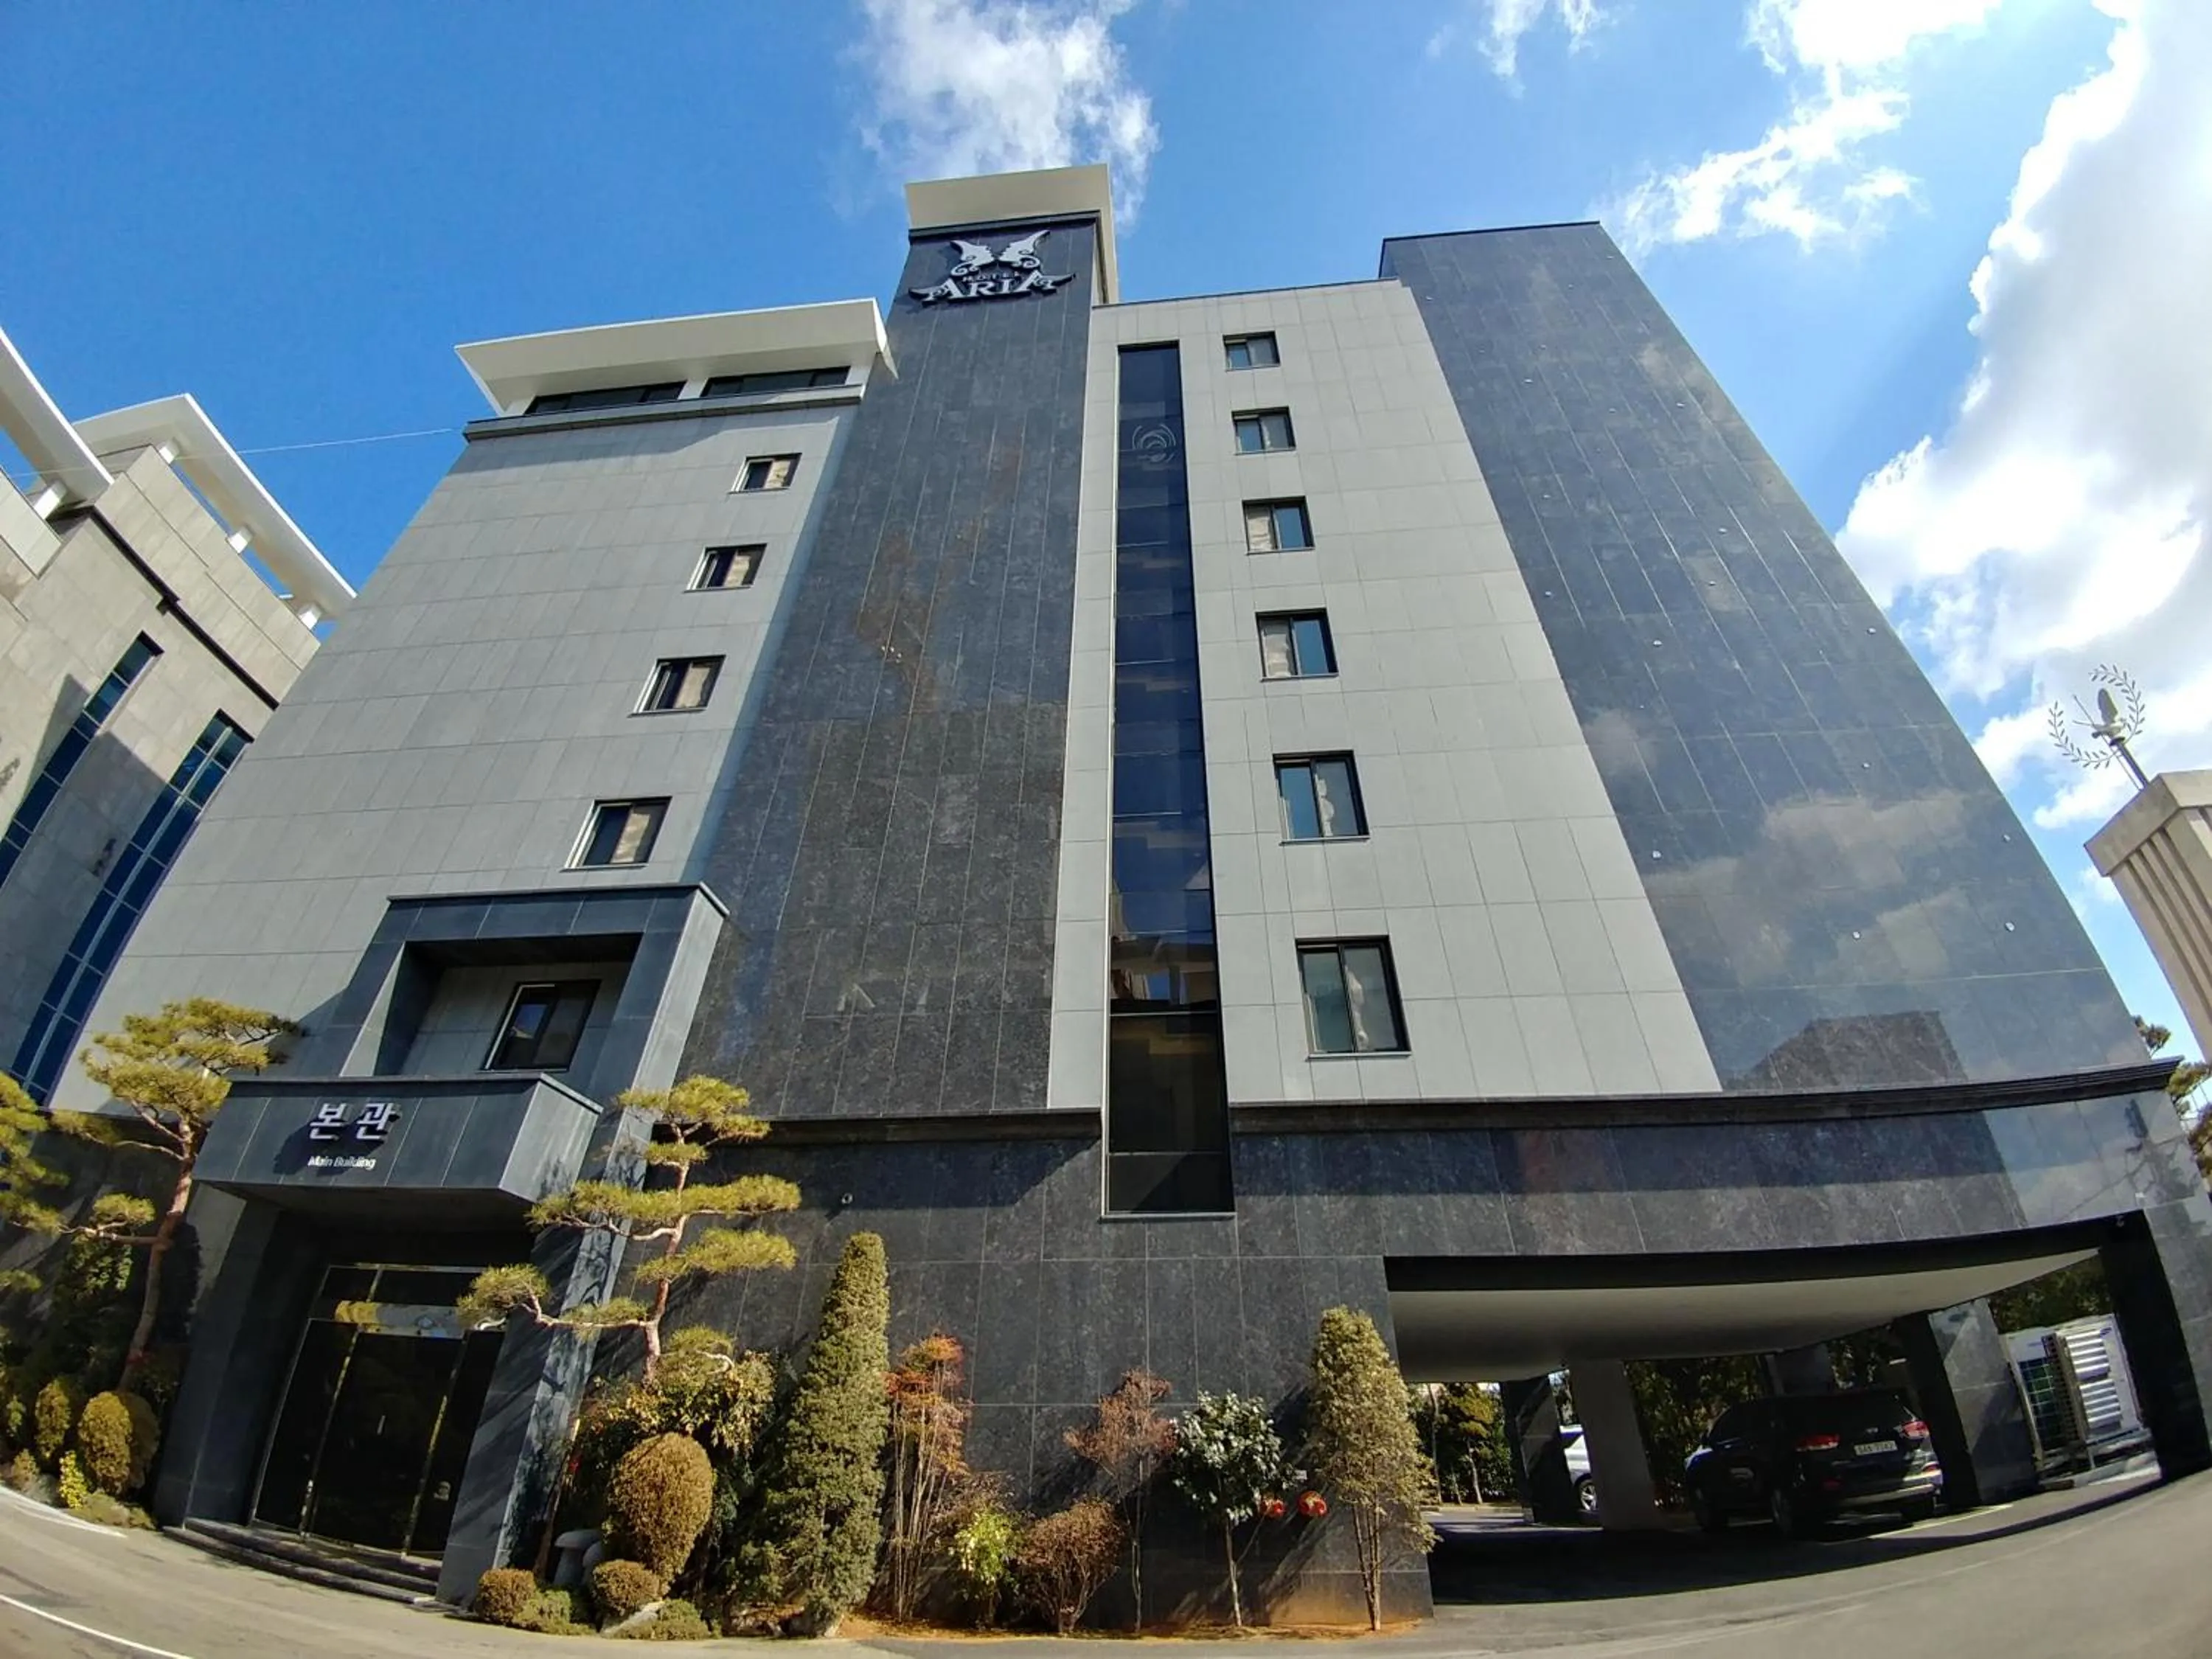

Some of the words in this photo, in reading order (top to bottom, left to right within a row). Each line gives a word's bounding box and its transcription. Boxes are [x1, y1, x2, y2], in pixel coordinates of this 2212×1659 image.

[920, 270, 1059, 301] ARIA
[309, 1103, 398, 1140] 본관
[307, 1155, 333, 1167] Main
[333, 1155, 377, 1171] Building
